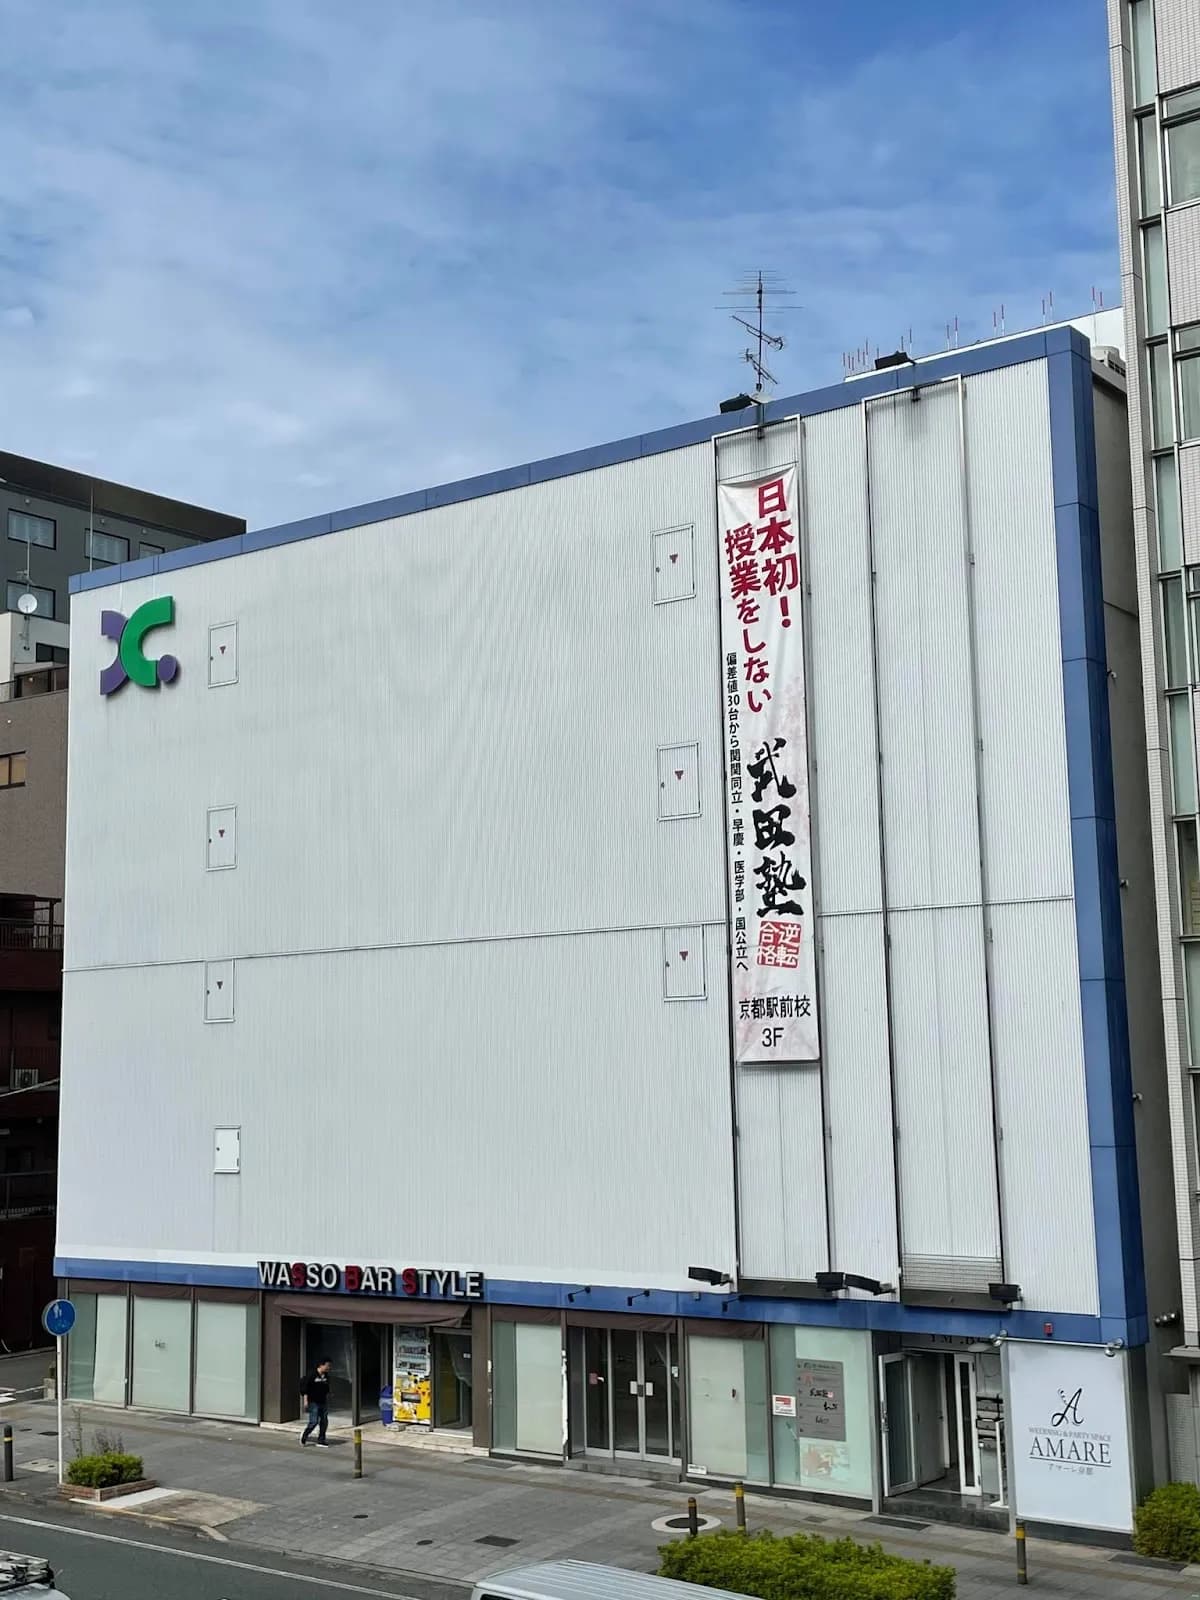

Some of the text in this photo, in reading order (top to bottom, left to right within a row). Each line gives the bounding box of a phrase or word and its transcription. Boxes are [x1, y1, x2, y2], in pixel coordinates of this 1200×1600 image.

[724, 522, 772, 712] 授業をしない
[747, 738, 806, 917] 武田塾
[739, 995, 811, 1019] 京都駅前校
[762, 1027, 784, 1047] 3F
[257, 1261, 484, 1298] WASSO BAR STYLE
[1030, 1436, 1112, 1464] AMARE
[1069, 1430, 1090, 1440] PARTY
[1090, 1432, 1111, 1442] SPACE
